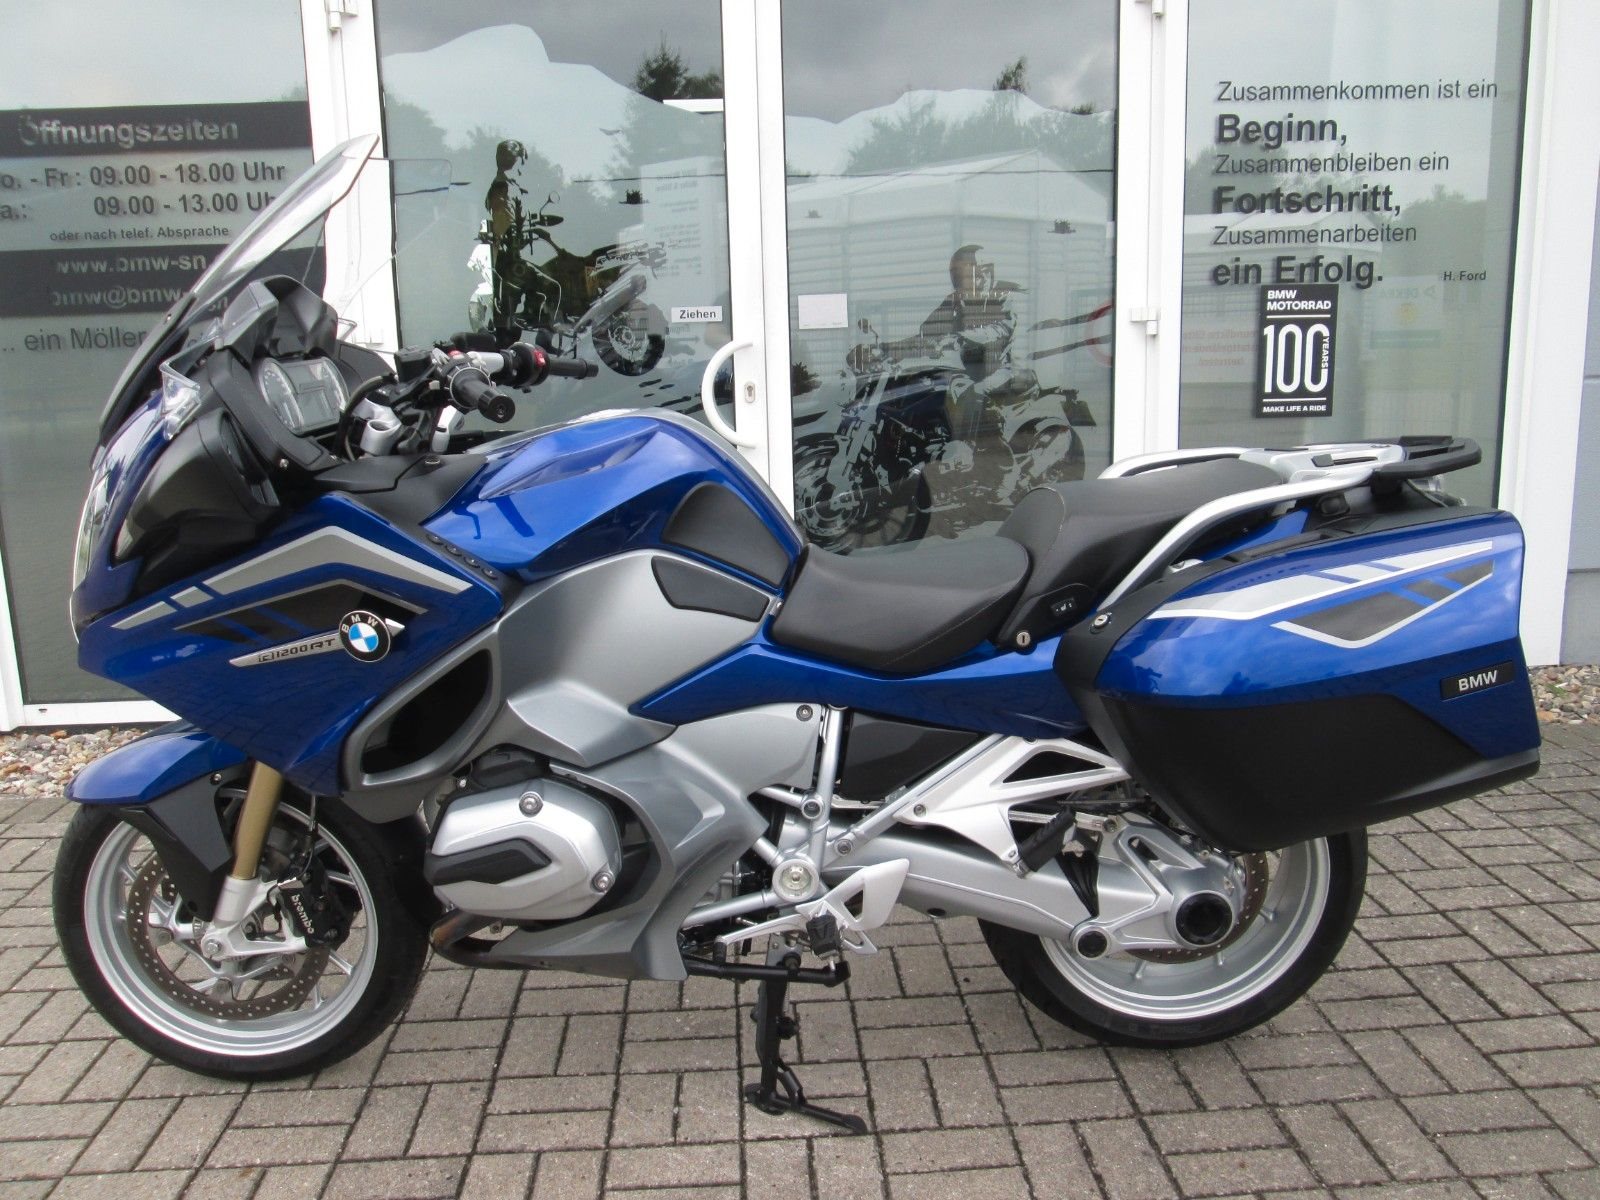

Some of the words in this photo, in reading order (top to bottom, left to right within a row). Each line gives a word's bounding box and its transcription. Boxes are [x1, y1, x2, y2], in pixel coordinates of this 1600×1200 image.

[1217, 79, 1430, 102] Zusammenkommen
[1437, 79, 1461, 99] ist
[1467, 78, 1498, 98] ein
[1217, 113, 1347, 150] Beginn,
[90, 165, 150, 187] 09.00
[175, 162, 235, 184] 18.00
[243, 161, 286, 181] Uhr
[1215, 152, 1411, 175] Zusammenbleiben
[1419, 151, 1449, 171] ein
[94, 196, 154, 216] 09.00
[179, 191, 239, 213] 13.00
[247, 191, 277, 211] Uh
[1213, 184, 1400, 216] Fortschritt,
[50, 231, 81, 242] oder
[84, 229, 116, 240] nach
[157, 226, 229, 242] Absprache
[1213, 223, 1417, 246] Zusammenarbeiten
[1213, 257, 1262, 286] ein
[1276, 256, 1383, 290] Erfolg.
[1443, 271, 1457, 282] H.
[1460, 270, 1487, 281] Ford
[1266, 300, 1332, 311] MOTORRAD
[1267, 290, 1297, 300] BMW
[679, 309, 717, 320] Ziehen
[24, 328, 60, 351] ein
[1263, 323, 1329, 393] 100
[1321, 336, 1329, 369] YEARS
[1310, 404, 1327, 412] RIDE
[341, 614, 379, 633] BMW
[1458, 669, 1498, 692] BMW
[291, 894, 315, 935] brembo
